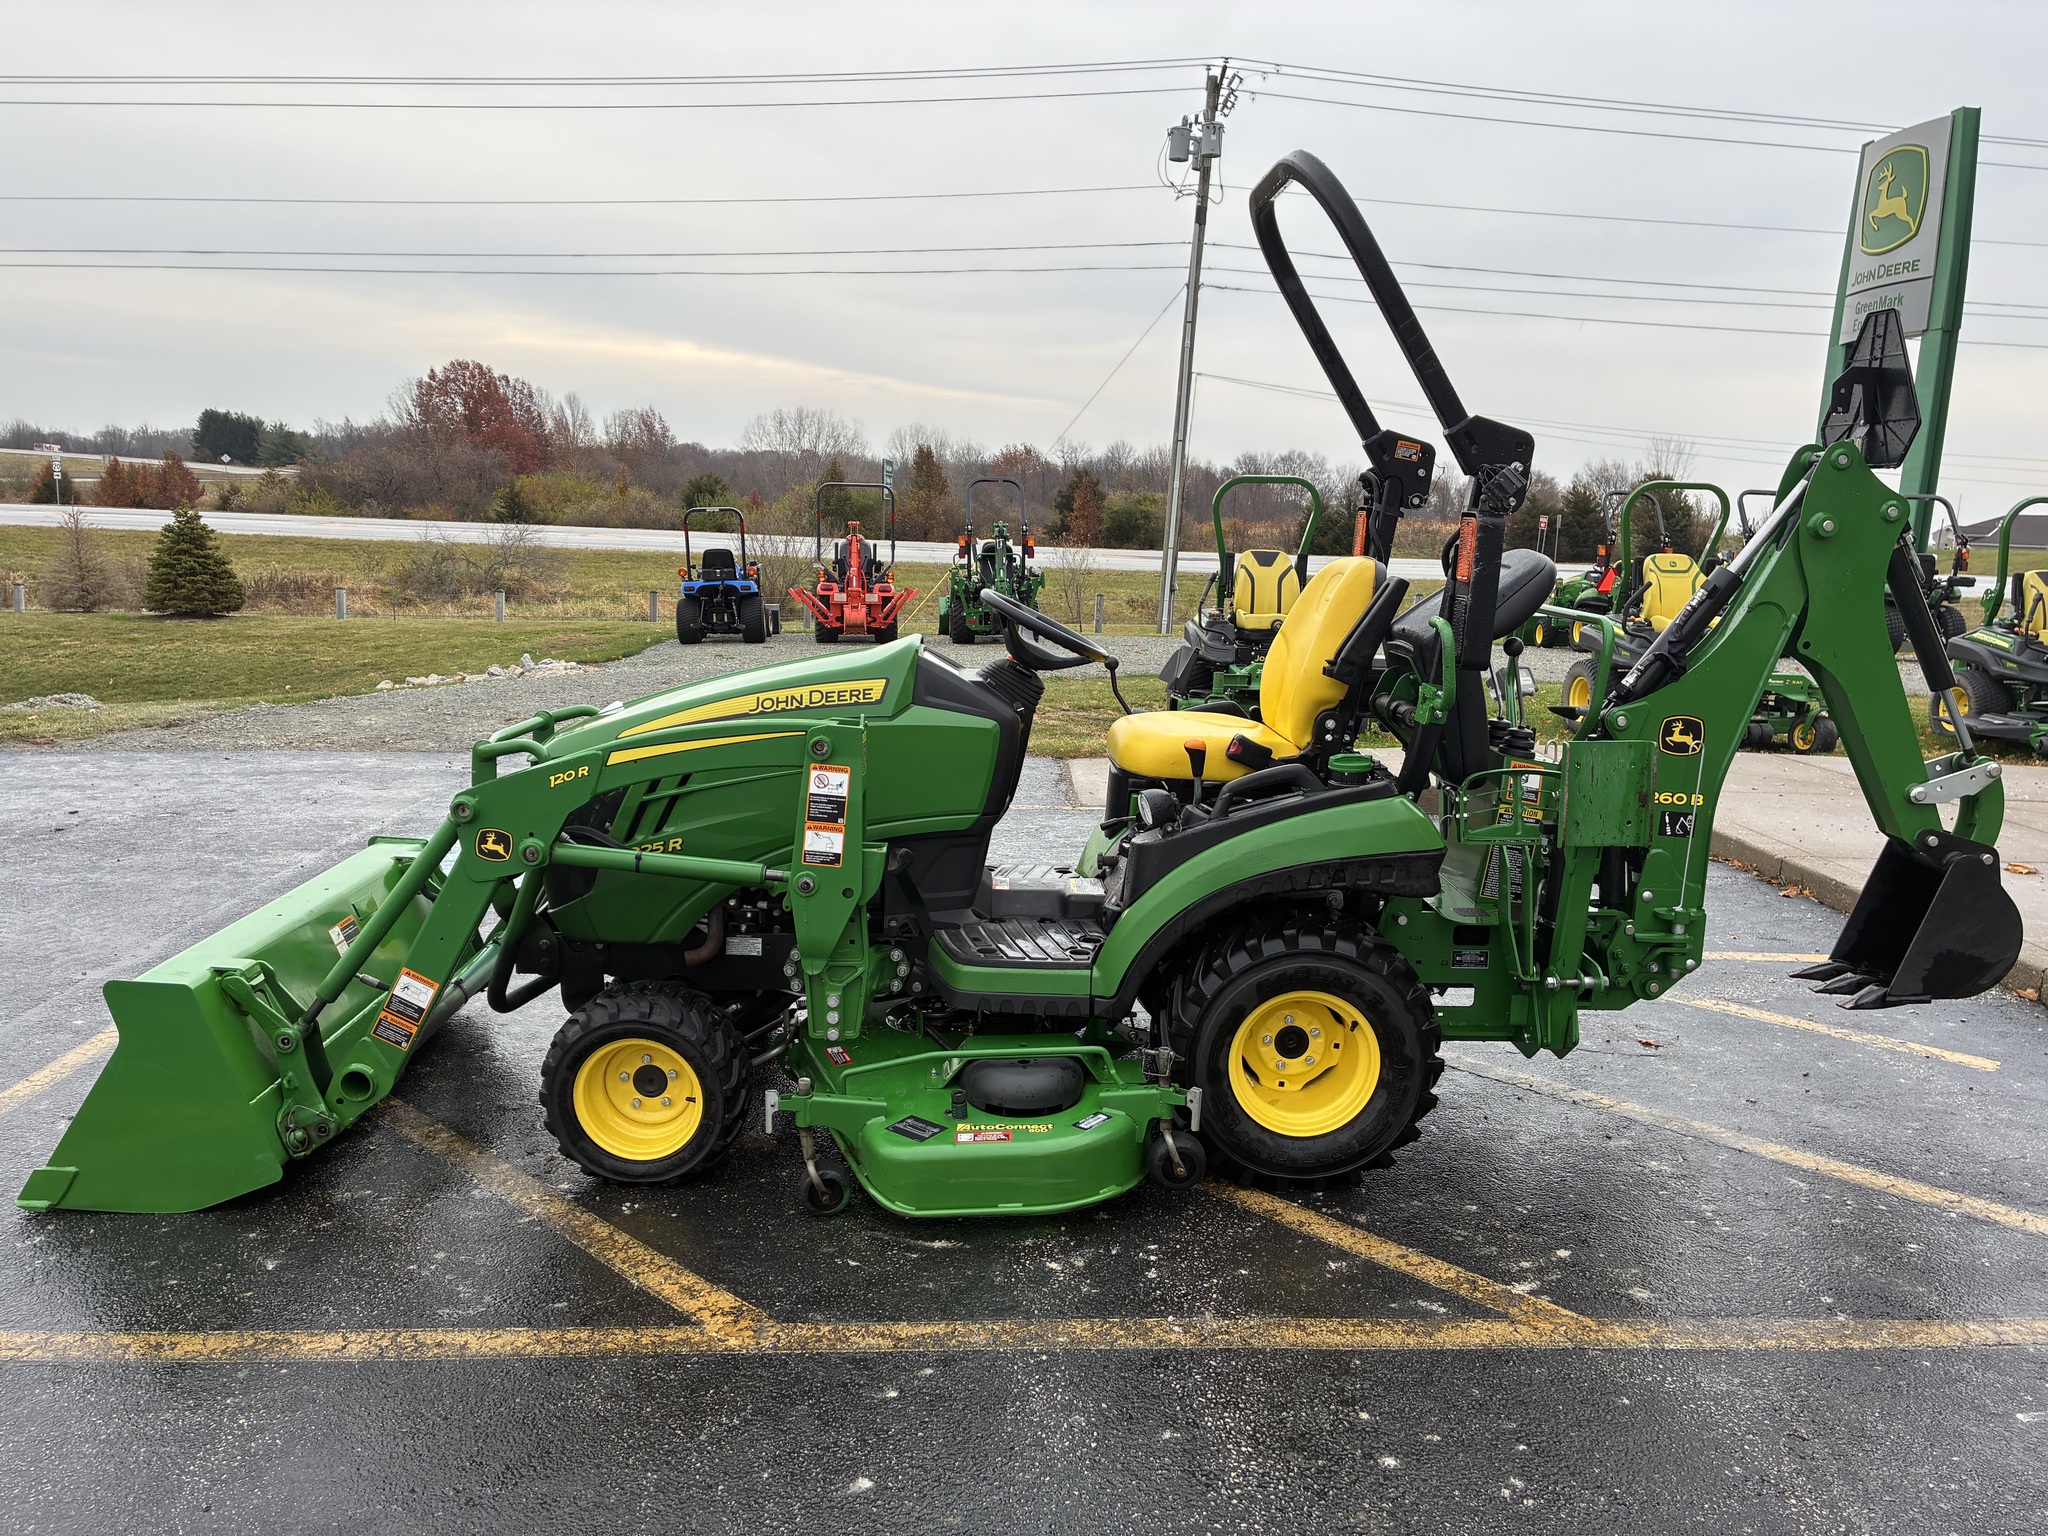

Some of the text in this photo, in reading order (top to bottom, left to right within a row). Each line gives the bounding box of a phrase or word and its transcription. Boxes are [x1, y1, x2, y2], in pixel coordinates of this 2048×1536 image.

[1851, 259, 1921, 287] JOHN DEERE
[1855, 293, 1904, 315] GreenMark
[748, 688, 874, 712] JOHN DEERE
[549, 765, 589, 788] 120 R
[818, 765, 849, 774] WARNING
[1690, 793, 1704, 806] B
[812, 824, 843, 833] WARNING
[668, 837, 683, 852] R
[411, 973, 434, 988] WARNING
[390, 1017, 413, 1031] WARNING
[956, 1123, 1054, 1131] AutoConnect
